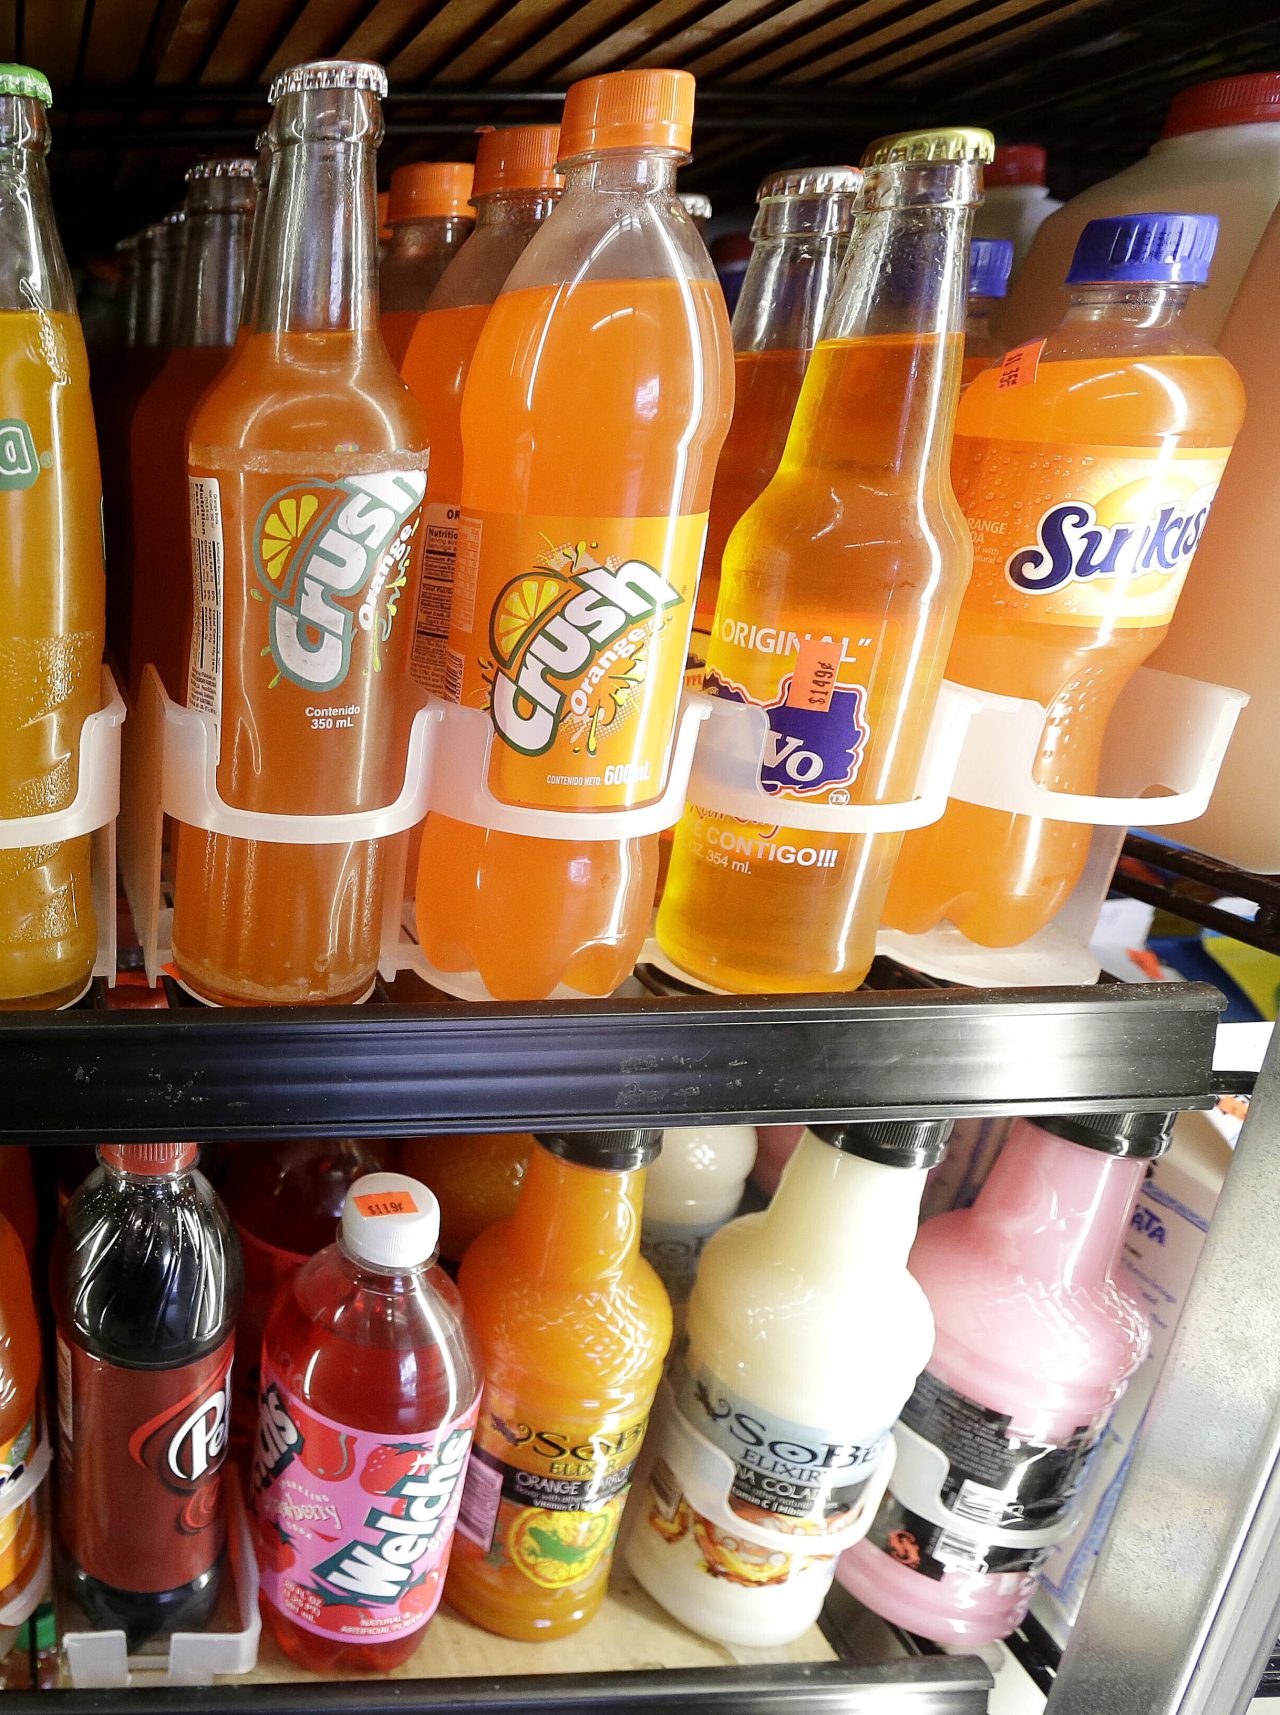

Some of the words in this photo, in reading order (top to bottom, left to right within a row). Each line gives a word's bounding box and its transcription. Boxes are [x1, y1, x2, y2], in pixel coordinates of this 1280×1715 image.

[1009, 501, 1213, 589] Sunkis
[358, 524, 413, 632] Orange
[493, 561, 682, 750] Crush
[571, 627, 646, 716] Orange
[305, 705, 361, 717] Contenido
[311, 719, 333, 730] 350
[336, 718, 354, 728] mL
[547, 775, 583, 786] CONTENIDO
[706, 826, 839, 868] CONTIGO!!!
[706, 849, 728, 867] 354
[731, 859, 752, 875] ml.
[550, 1461, 616, 1477] ELIXR
[742, 1448, 822, 1482] ELIXIR
[516, 1472, 581, 1495] ORANGE
[326, 1430, 472, 1598] Welchs
